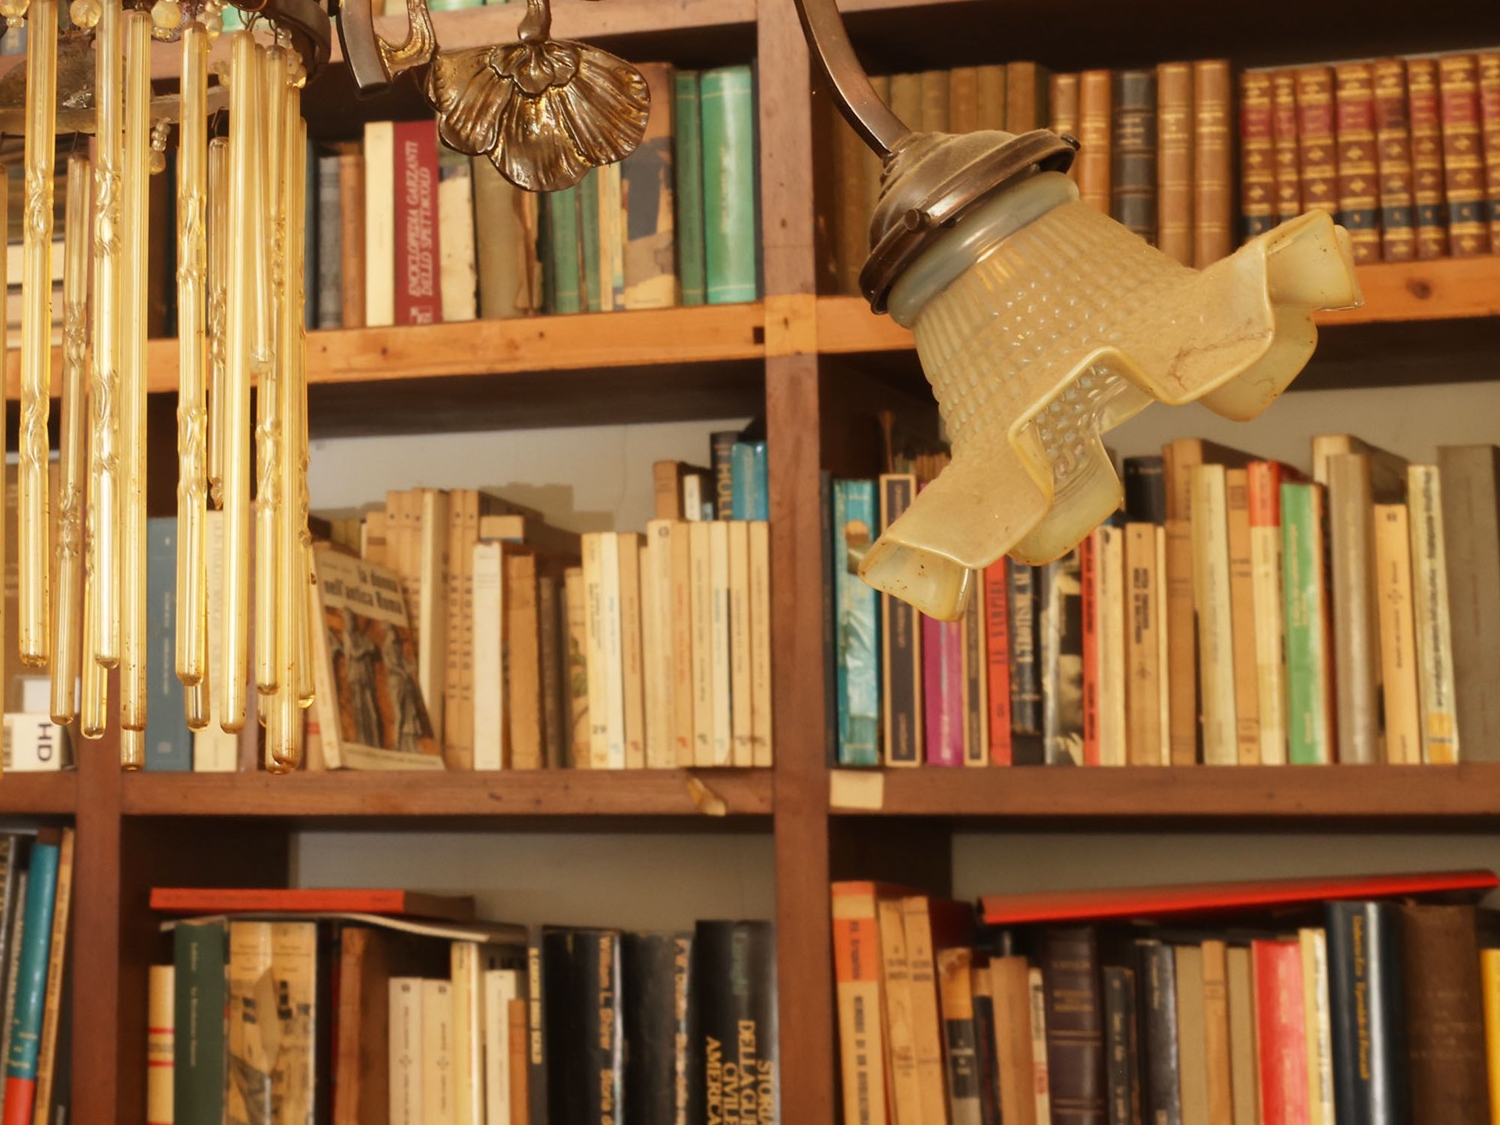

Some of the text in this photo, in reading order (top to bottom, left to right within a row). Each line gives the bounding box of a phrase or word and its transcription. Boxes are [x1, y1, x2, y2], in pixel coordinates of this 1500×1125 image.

[405, 140, 421, 297] ENCICLOPEDIA GARZANTI
[419, 166, 434, 296] DELLO SPETTACOLO
[36, 722, 53, 762] HD
[738, 1019, 757, 1086] DELLA
